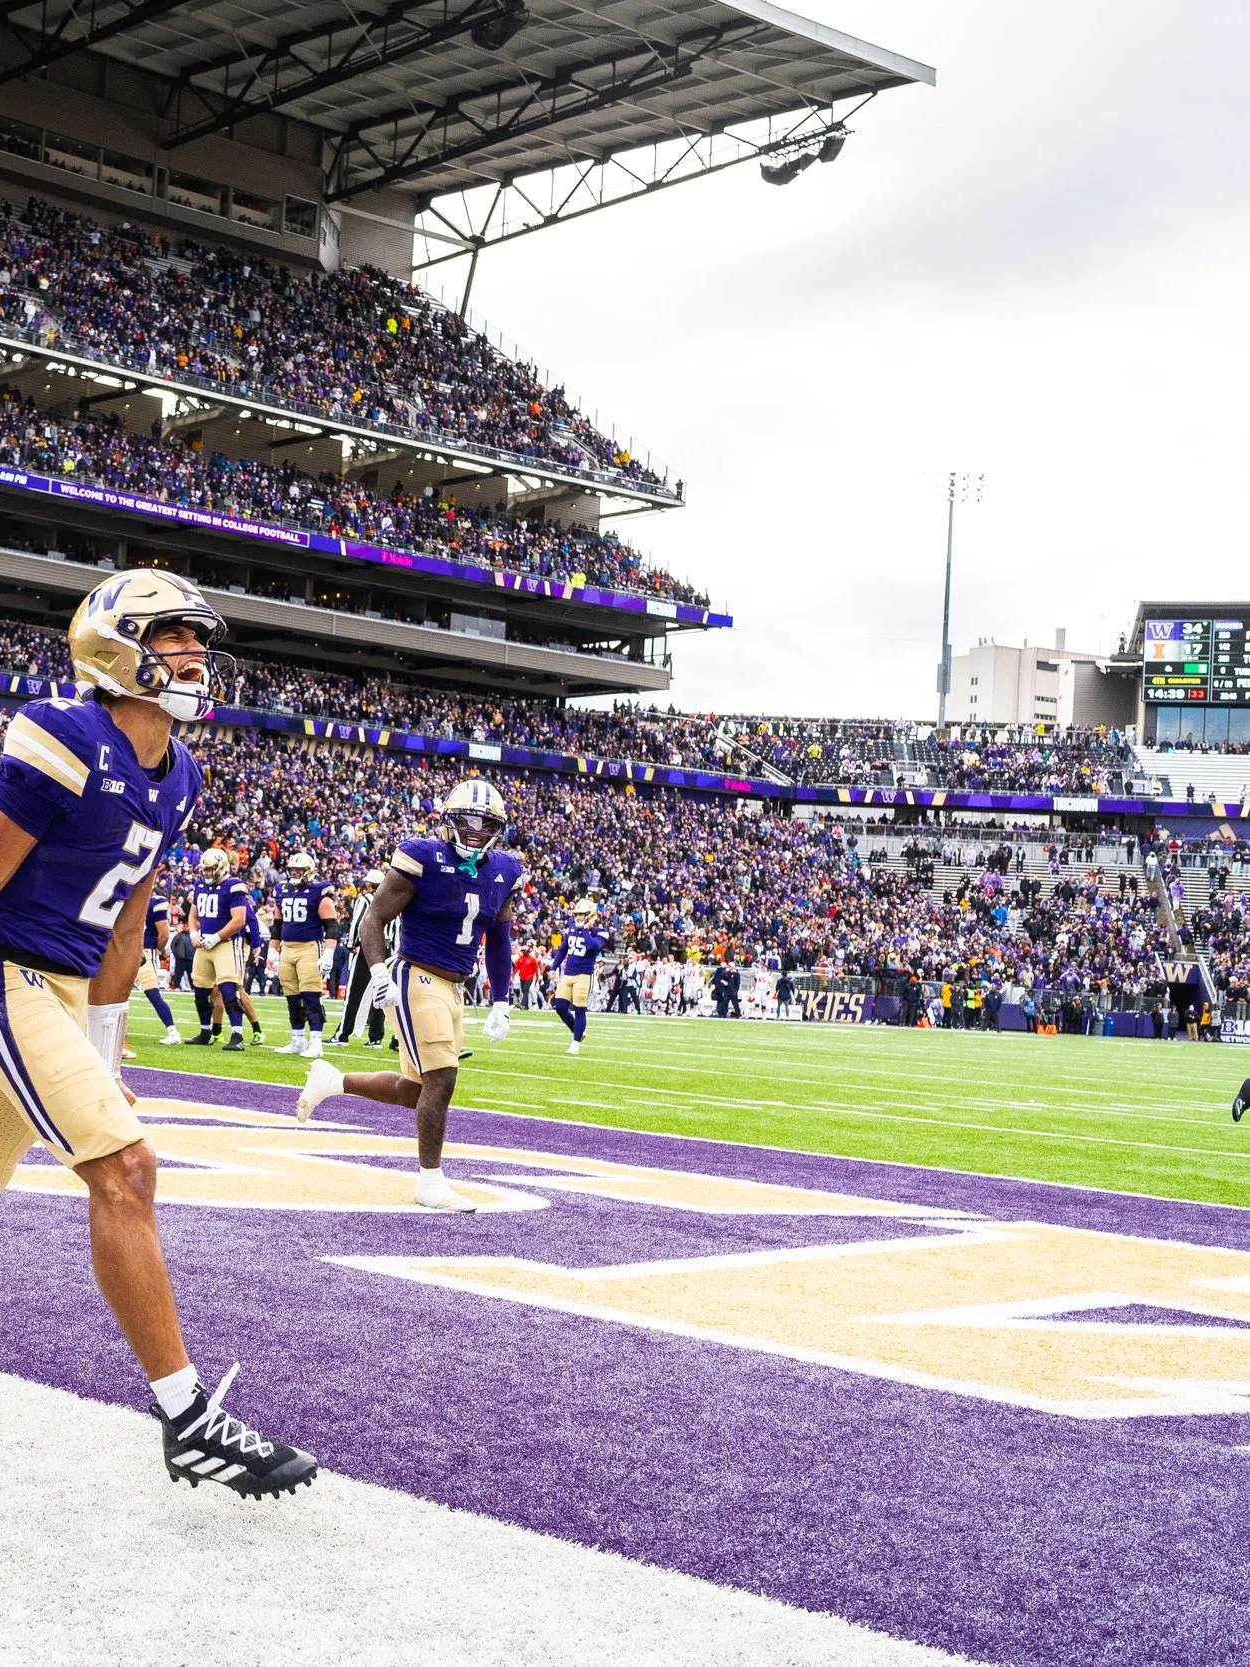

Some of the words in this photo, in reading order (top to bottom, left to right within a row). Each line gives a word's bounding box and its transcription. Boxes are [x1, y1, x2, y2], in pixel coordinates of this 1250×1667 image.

[60, 484, 104, 501] WELCOME
[104, 494, 117, 504] TO
[118, 496, 135, 507] THE
[135, 500, 177, 517] GREATEST
[178, 508, 212, 524] SETTING
[212, 516, 222, 527] IN
[222, 519, 259, 534] COLLEGE
[259, 526, 300, 543] FOOTBALL
[87, 578, 132, 617] W
[1149, 622, 1174, 640] W
[1182, 622, 1203, 634] 34
[1183, 643, 1203, 655] 17
[1147, 688, 1185, 699] 14:39
[1191, 690, 1204, 698] 33
[99, 744, 110, 771] C
[148, 788, 159, 803] W
[78, 821, 163, 930] 2
[197, 893, 219, 918] 80
[281, 897, 308, 922] 66
[455, 893, 480, 945] 1
[567, 935, 587, 958] 95
[18, 966, 45, 989] W
[419, 975, 432, 986] W
[1164, 963, 1193, 984] W
